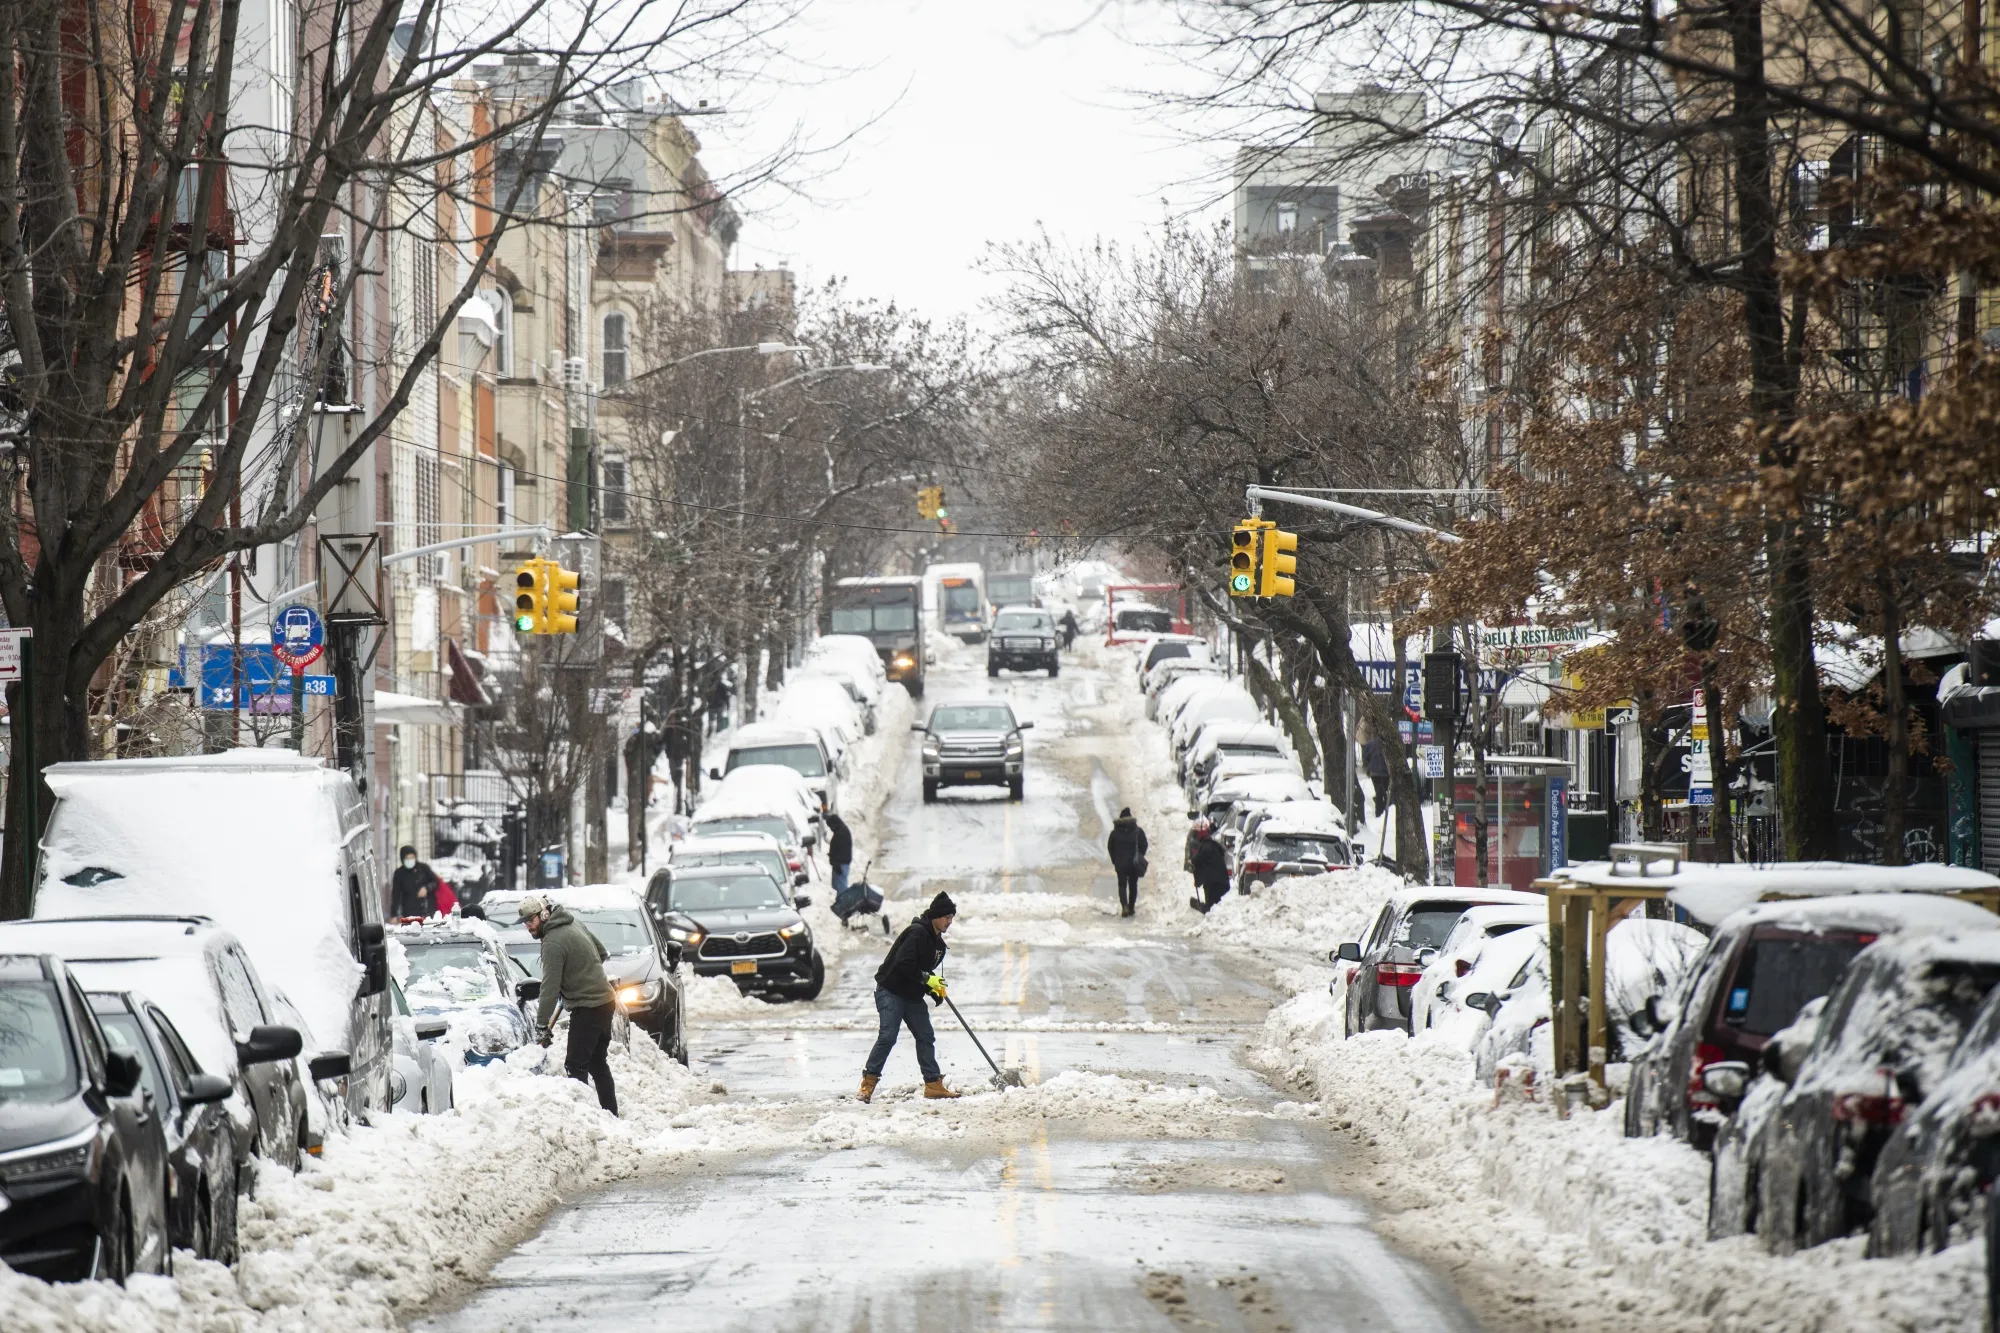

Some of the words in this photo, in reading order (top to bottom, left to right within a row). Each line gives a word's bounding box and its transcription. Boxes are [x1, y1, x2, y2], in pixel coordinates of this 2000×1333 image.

[1521, 626, 1588, 643] RESTAURANT
[287, 646, 320, 665] TANDING
[1551, 789, 1560, 818] Dekalb
[1551, 819, 1559, 835] Ave
